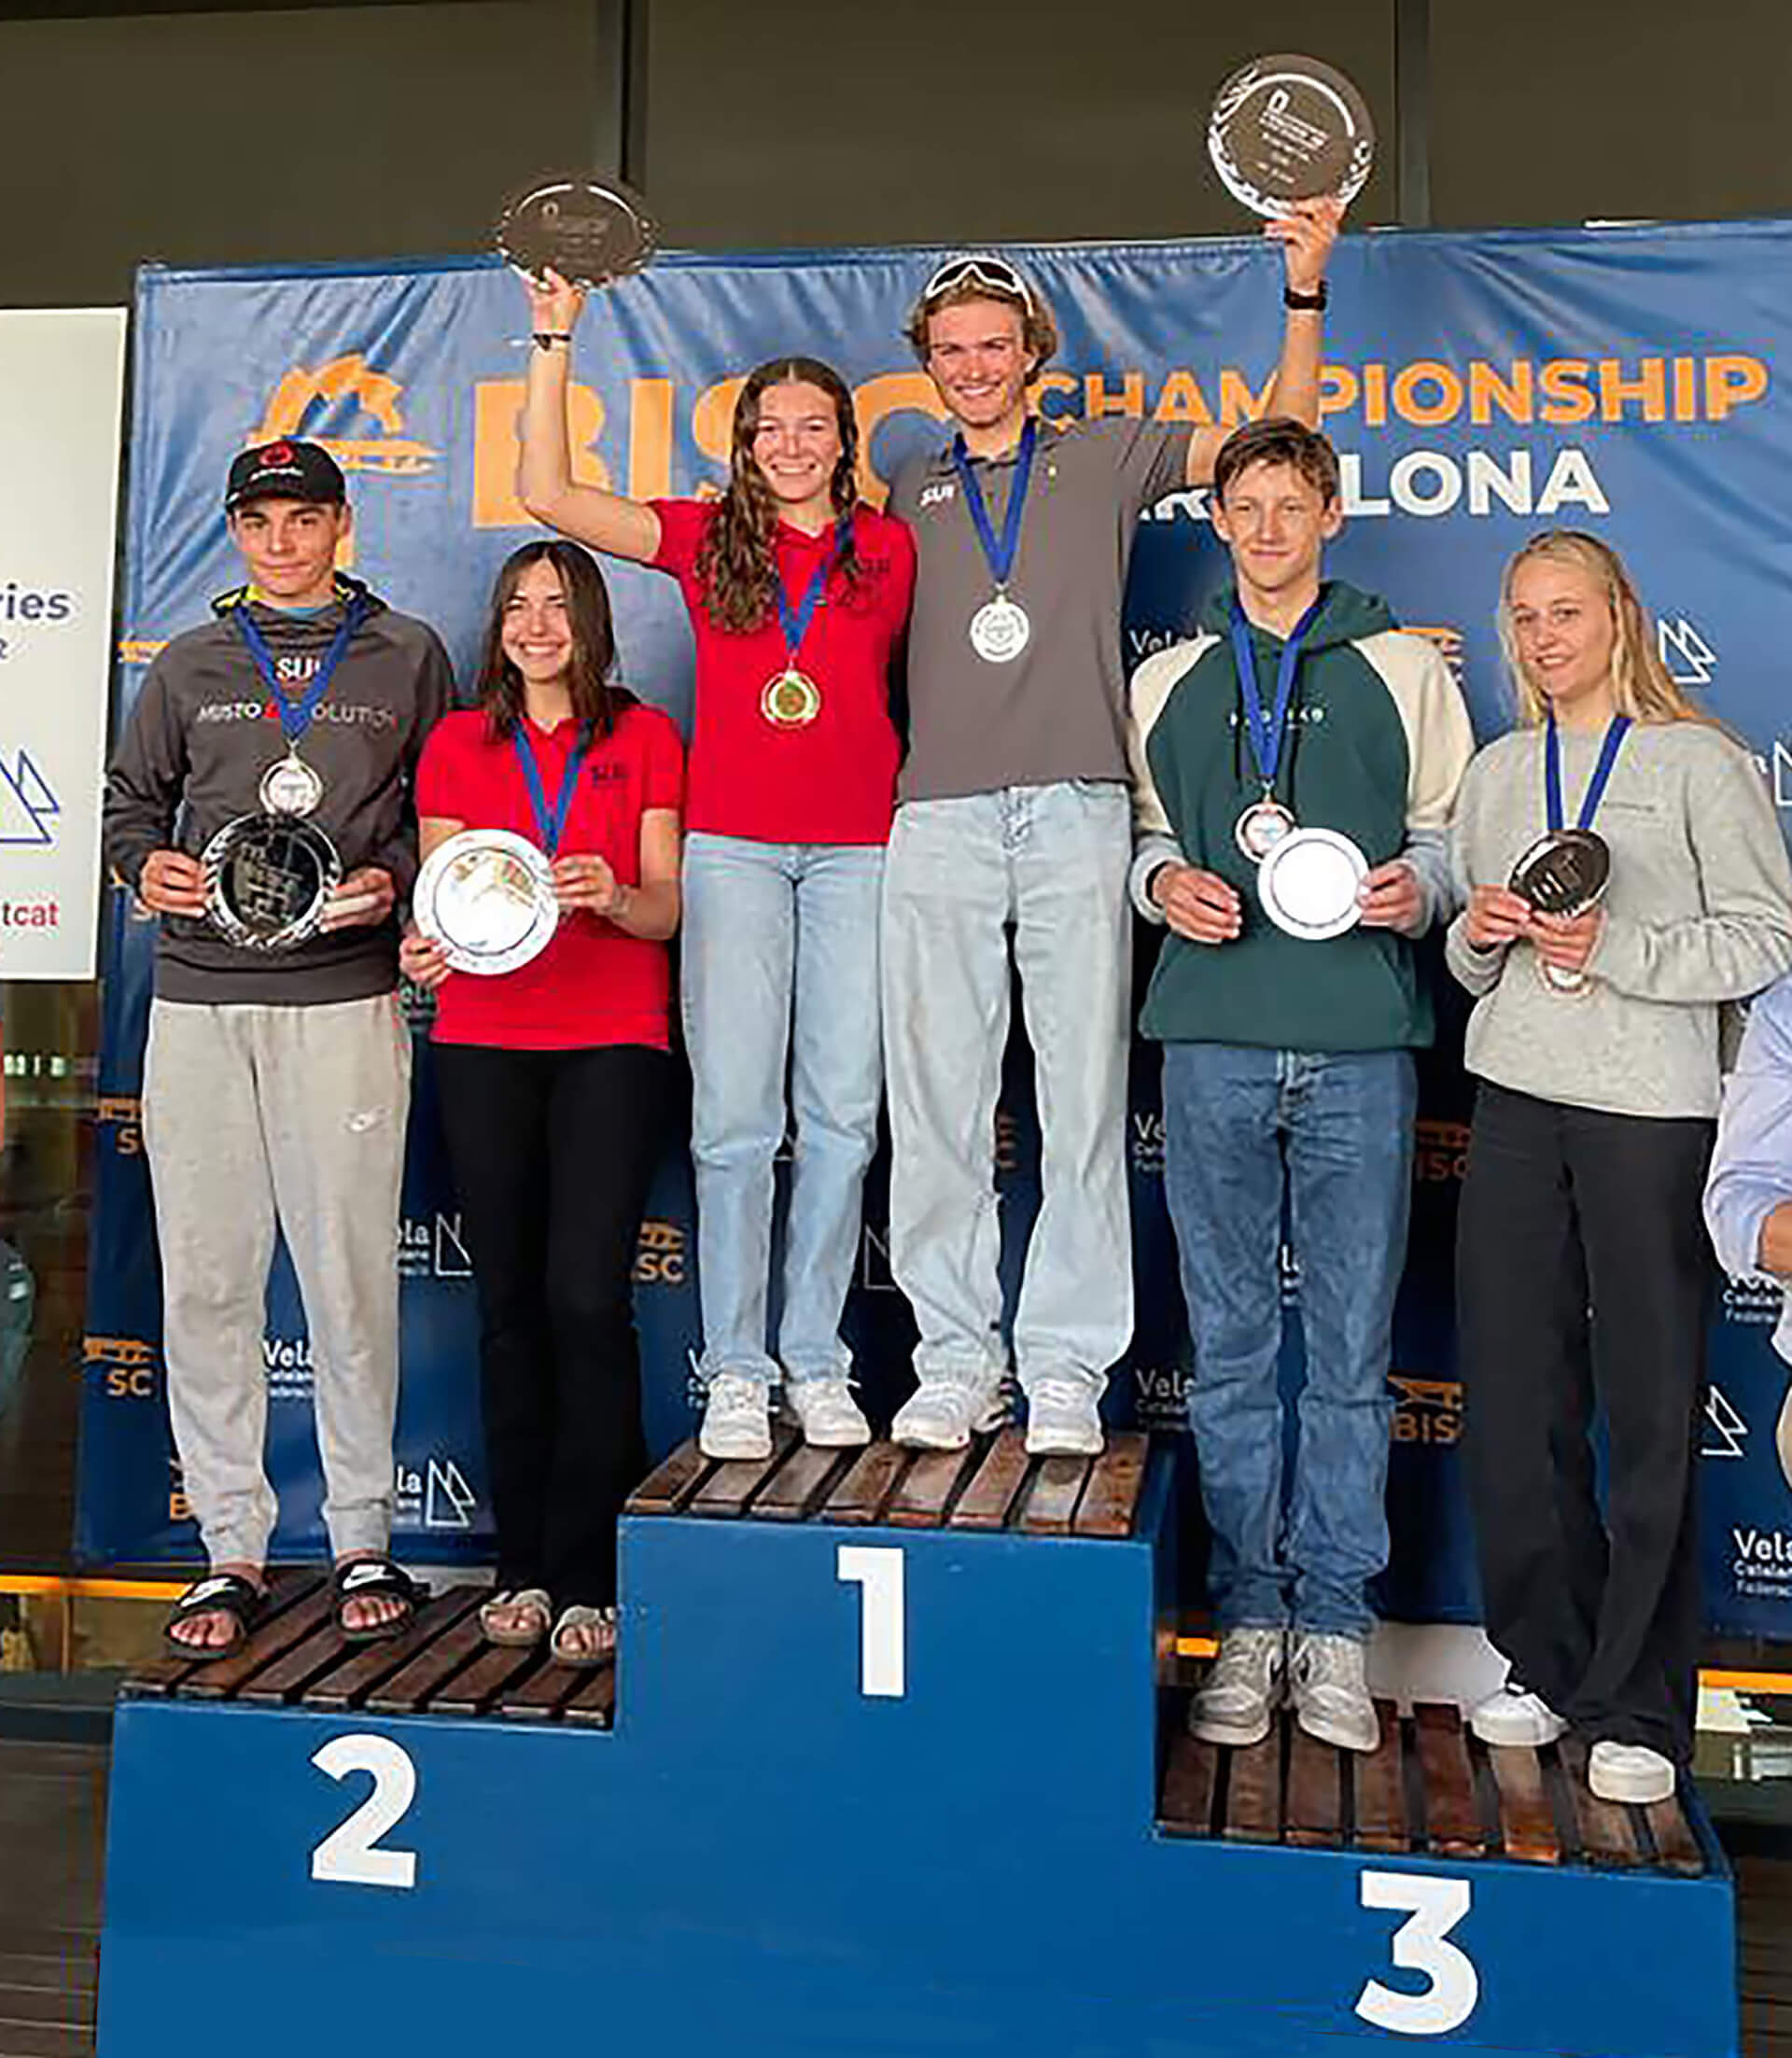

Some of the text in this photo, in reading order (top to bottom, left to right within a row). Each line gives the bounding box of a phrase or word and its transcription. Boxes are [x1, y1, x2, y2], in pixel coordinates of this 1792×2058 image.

[1026, 355, 1769, 430] CHAMPIONSHIP
[0, 582, 70, 621] ies
[1393, 1412, 1462, 1444] BIS
[836, 1546, 905, 1698] 1
[310, 1733, 417, 1889] 2
[1354, 1869, 1479, 2036] 3
